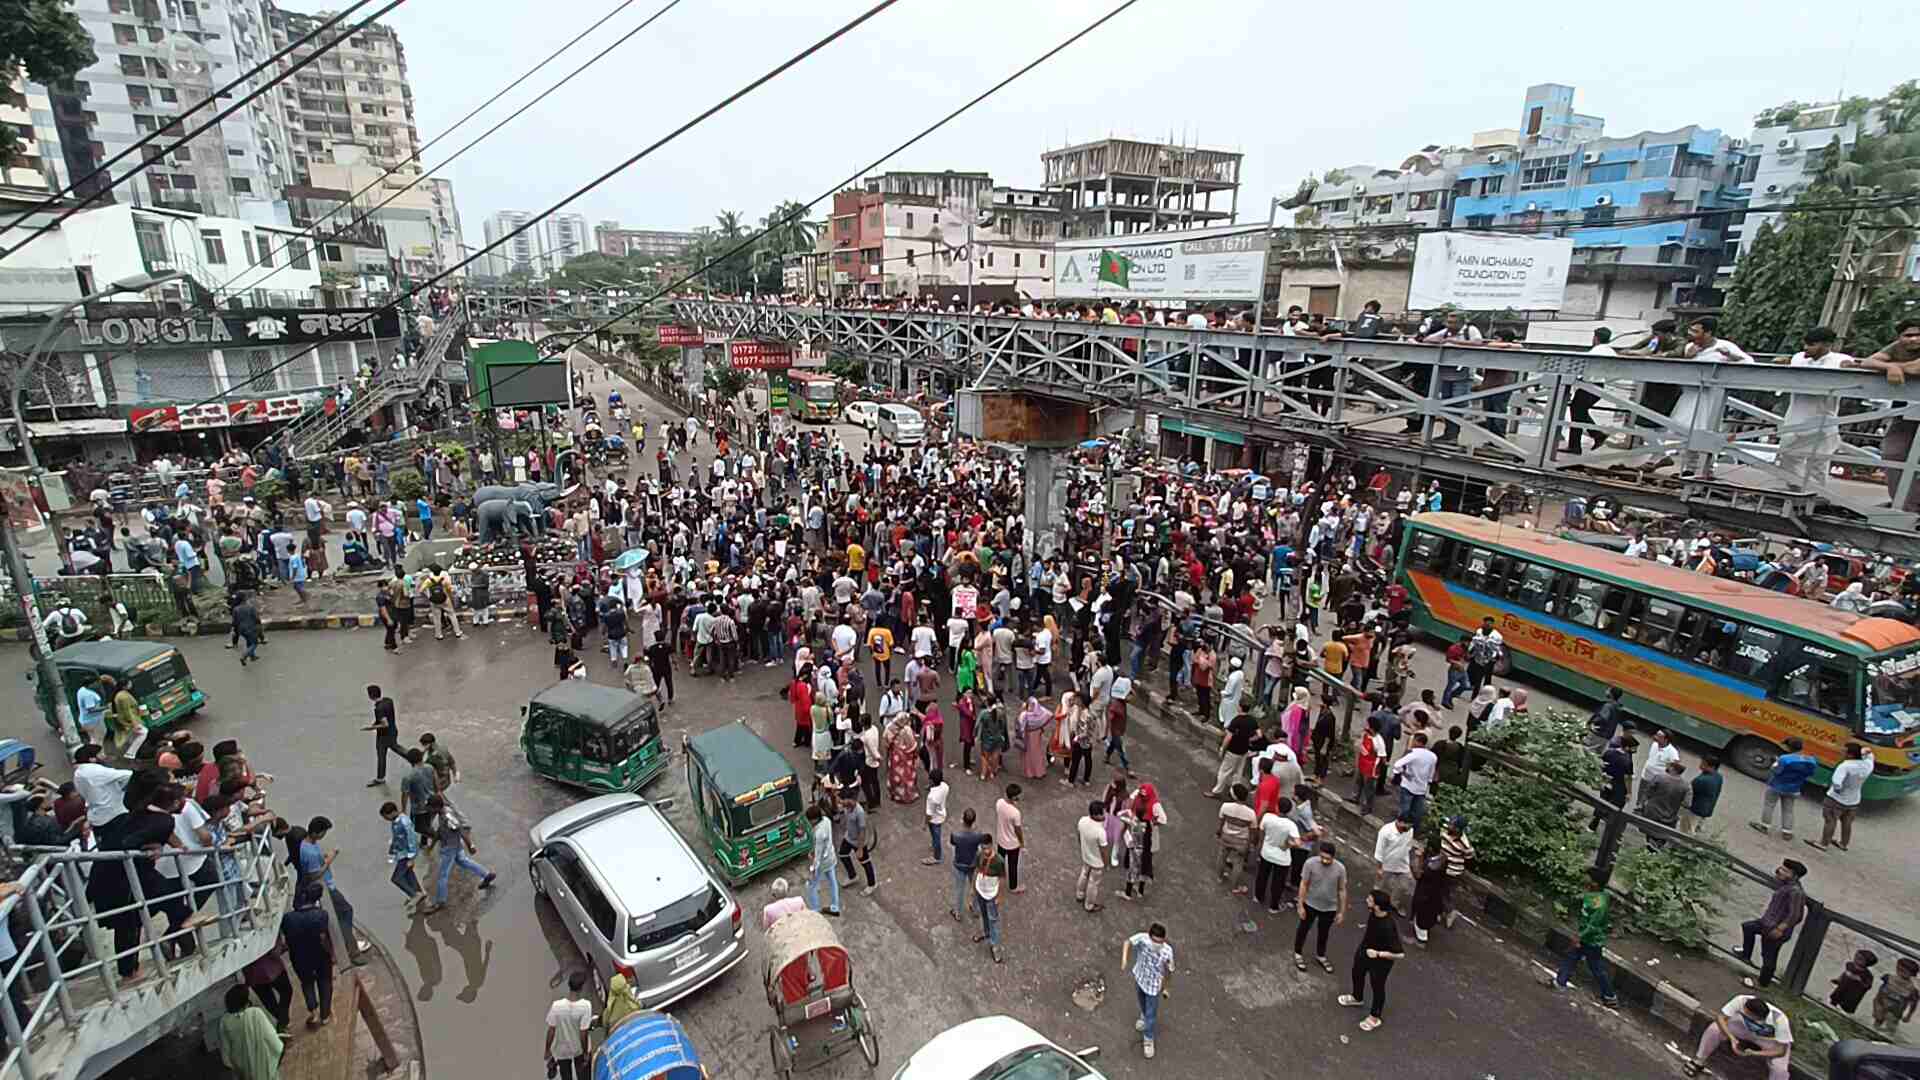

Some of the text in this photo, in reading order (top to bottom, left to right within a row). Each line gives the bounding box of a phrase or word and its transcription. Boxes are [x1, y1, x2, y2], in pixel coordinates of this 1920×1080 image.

[1222, 236, 1252, 251] 16711
[1456, 255, 1534, 267] AMIN MOHAMMAD
[1457, 269, 1510, 279] FOUNDATION
[75, 316, 232, 344] LONGLA
